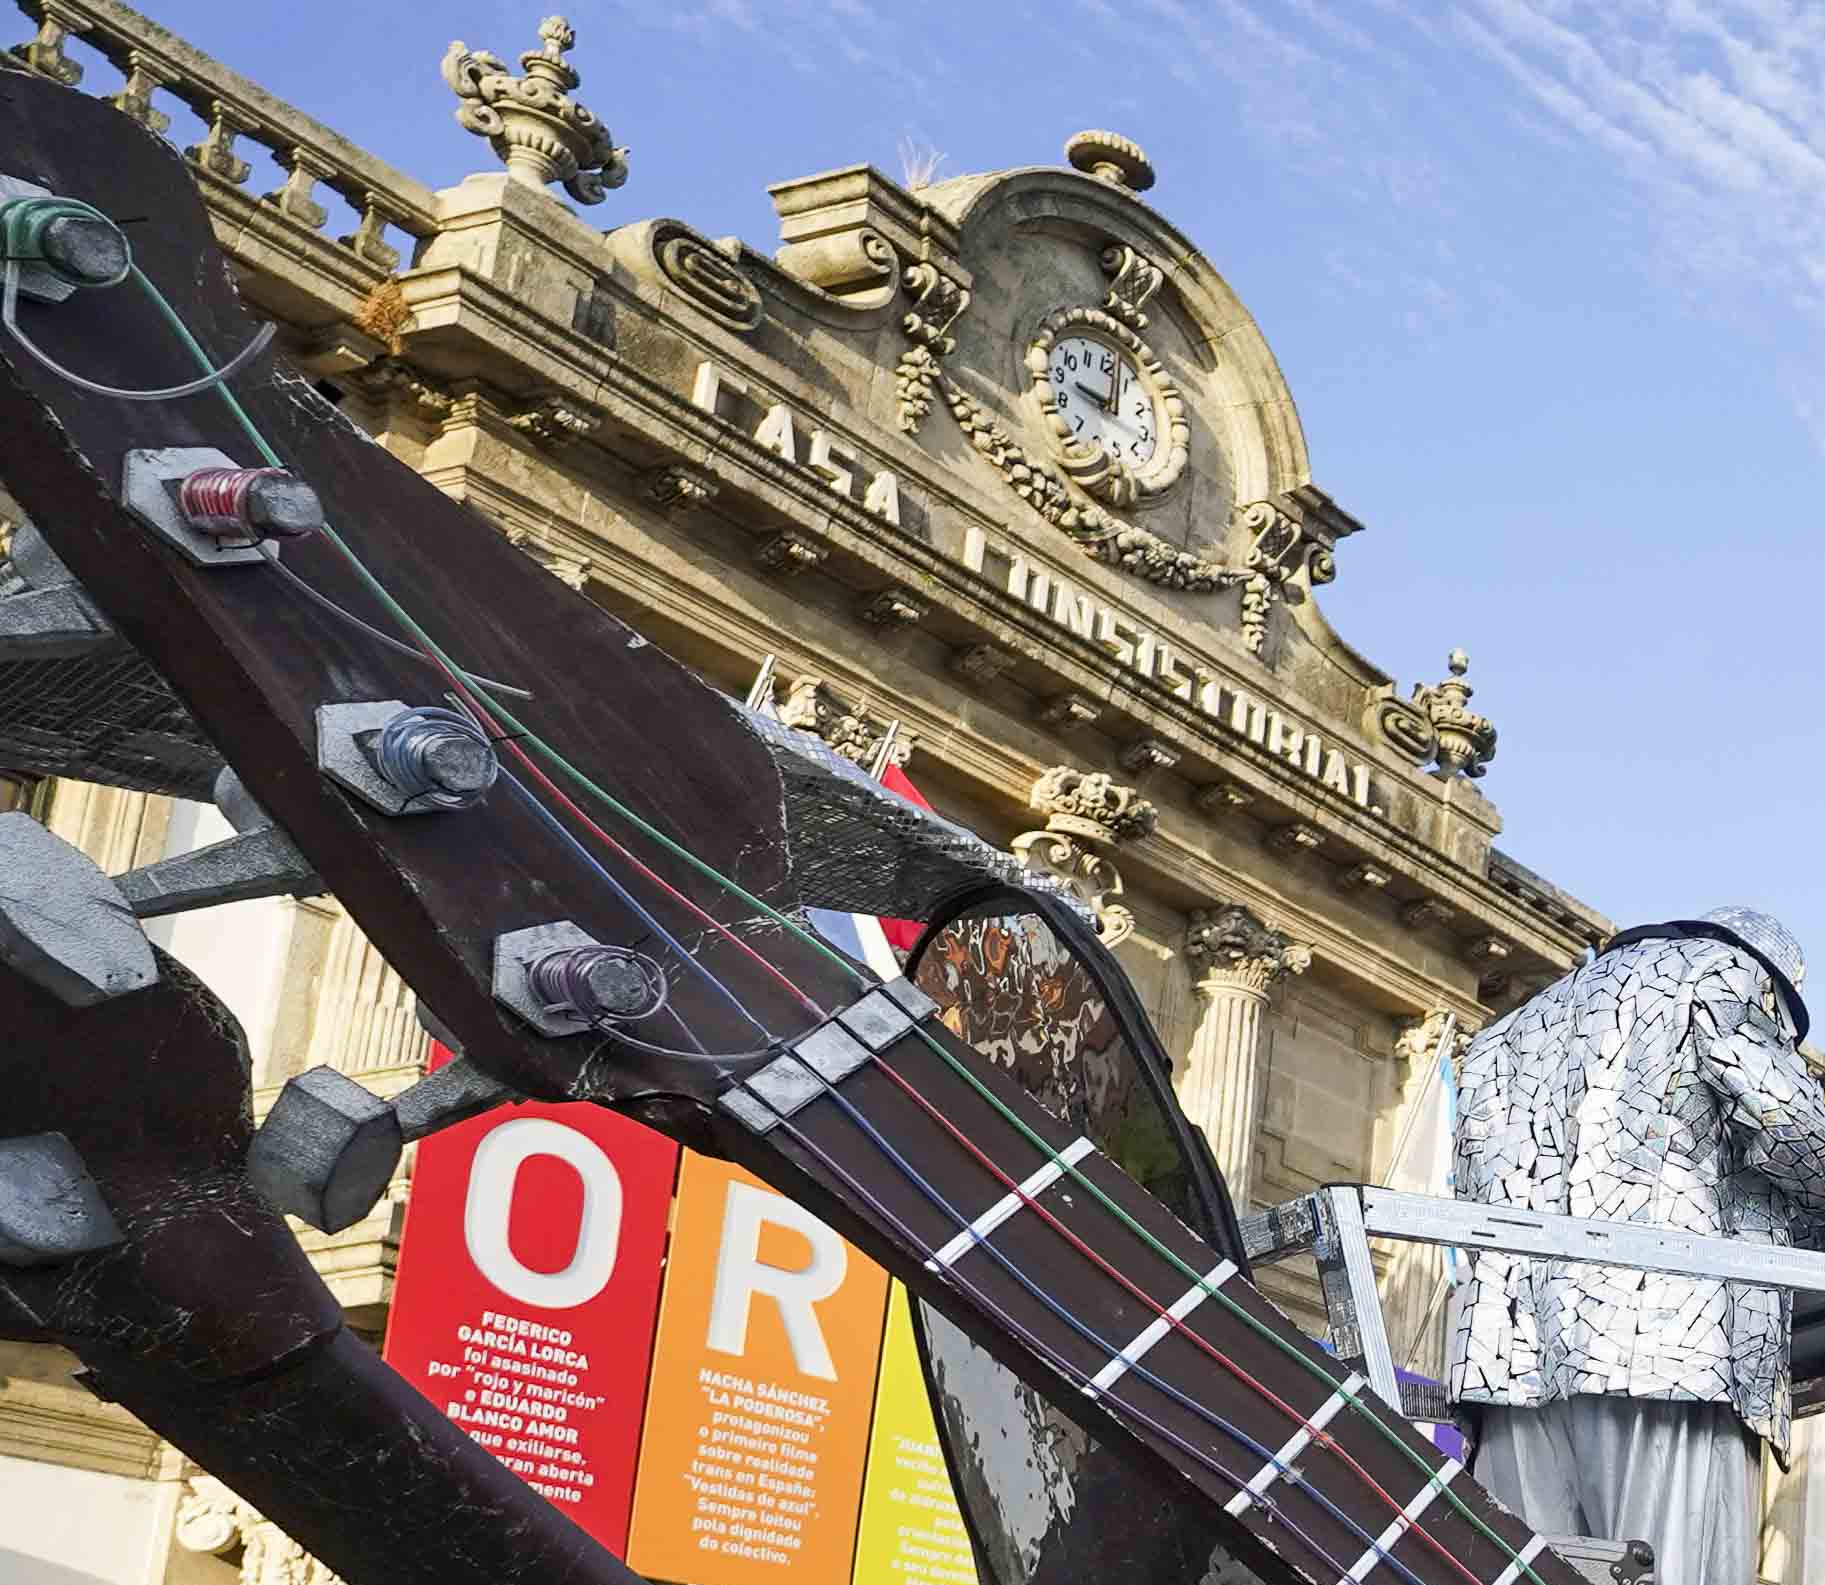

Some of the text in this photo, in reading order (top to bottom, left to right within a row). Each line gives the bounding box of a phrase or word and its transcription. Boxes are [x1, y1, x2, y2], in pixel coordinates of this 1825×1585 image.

[1055, 367, 1065, 383] 9
[1064, 350, 1077, 371] 10
[1058, 392, 1068, 409] 8
[1075, 415, 1084, 432] 7
[692, 360, 1383, 817] CASA CONSISTORIAL
[463, 1116, 623, 1309] O
[705, 1179, 838, 1383] R
[481, 1311, 573, 1346] FEDERICO
[457, 1325, 589, 1370] GARCÍA LORCA
[428, 1360, 461, 1377] por
[513, 1380, 523, 1395] y
[464, 1347, 578, 1386] foi asasinado
[699, 1367, 753, 1393] NACHA
[480, 1389, 567, 1421] EDUARDO
[447, 1402, 578, 1444] BLANCO AMOR
[712, 1411, 809, 1443] protagonizou
[698, 1426, 817, 1463] o primeiro filme
[538, 1463, 594, 1486] aberta
[691, 1459, 733, 1480] trans
[735, 1472, 755, 1485] en
[698, 1444, 815, 1480] sobre realidade
[697, 1497, 802, 1531] Sempre loitou
[757, 1493, 776, 1507] de
[692, 1517, 802, 1549] pola dignidade
[698, 1535, 719, 1549] do
